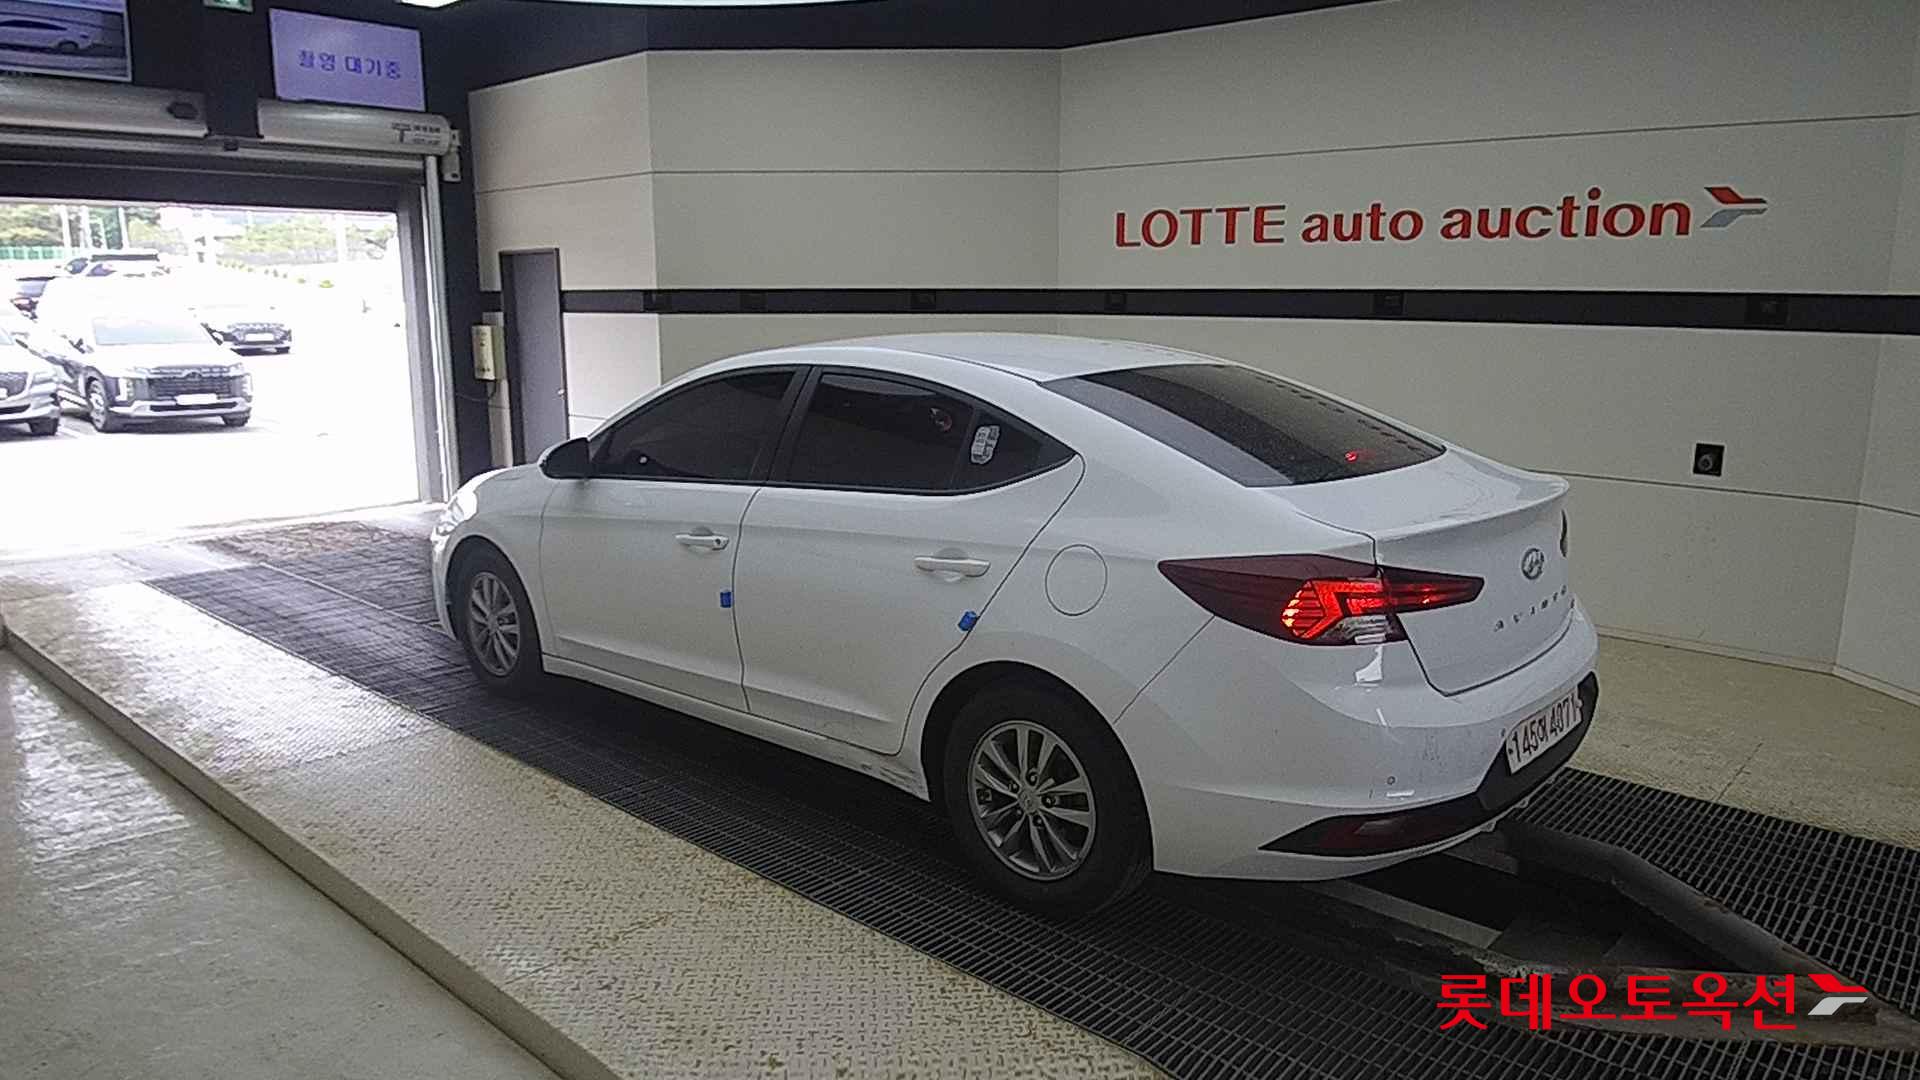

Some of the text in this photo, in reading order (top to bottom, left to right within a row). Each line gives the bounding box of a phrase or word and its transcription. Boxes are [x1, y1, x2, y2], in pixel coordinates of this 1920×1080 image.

[345, 56, 401, 80] 대기중
[1115, 187, 1691, 247] LOTTE auto auction
